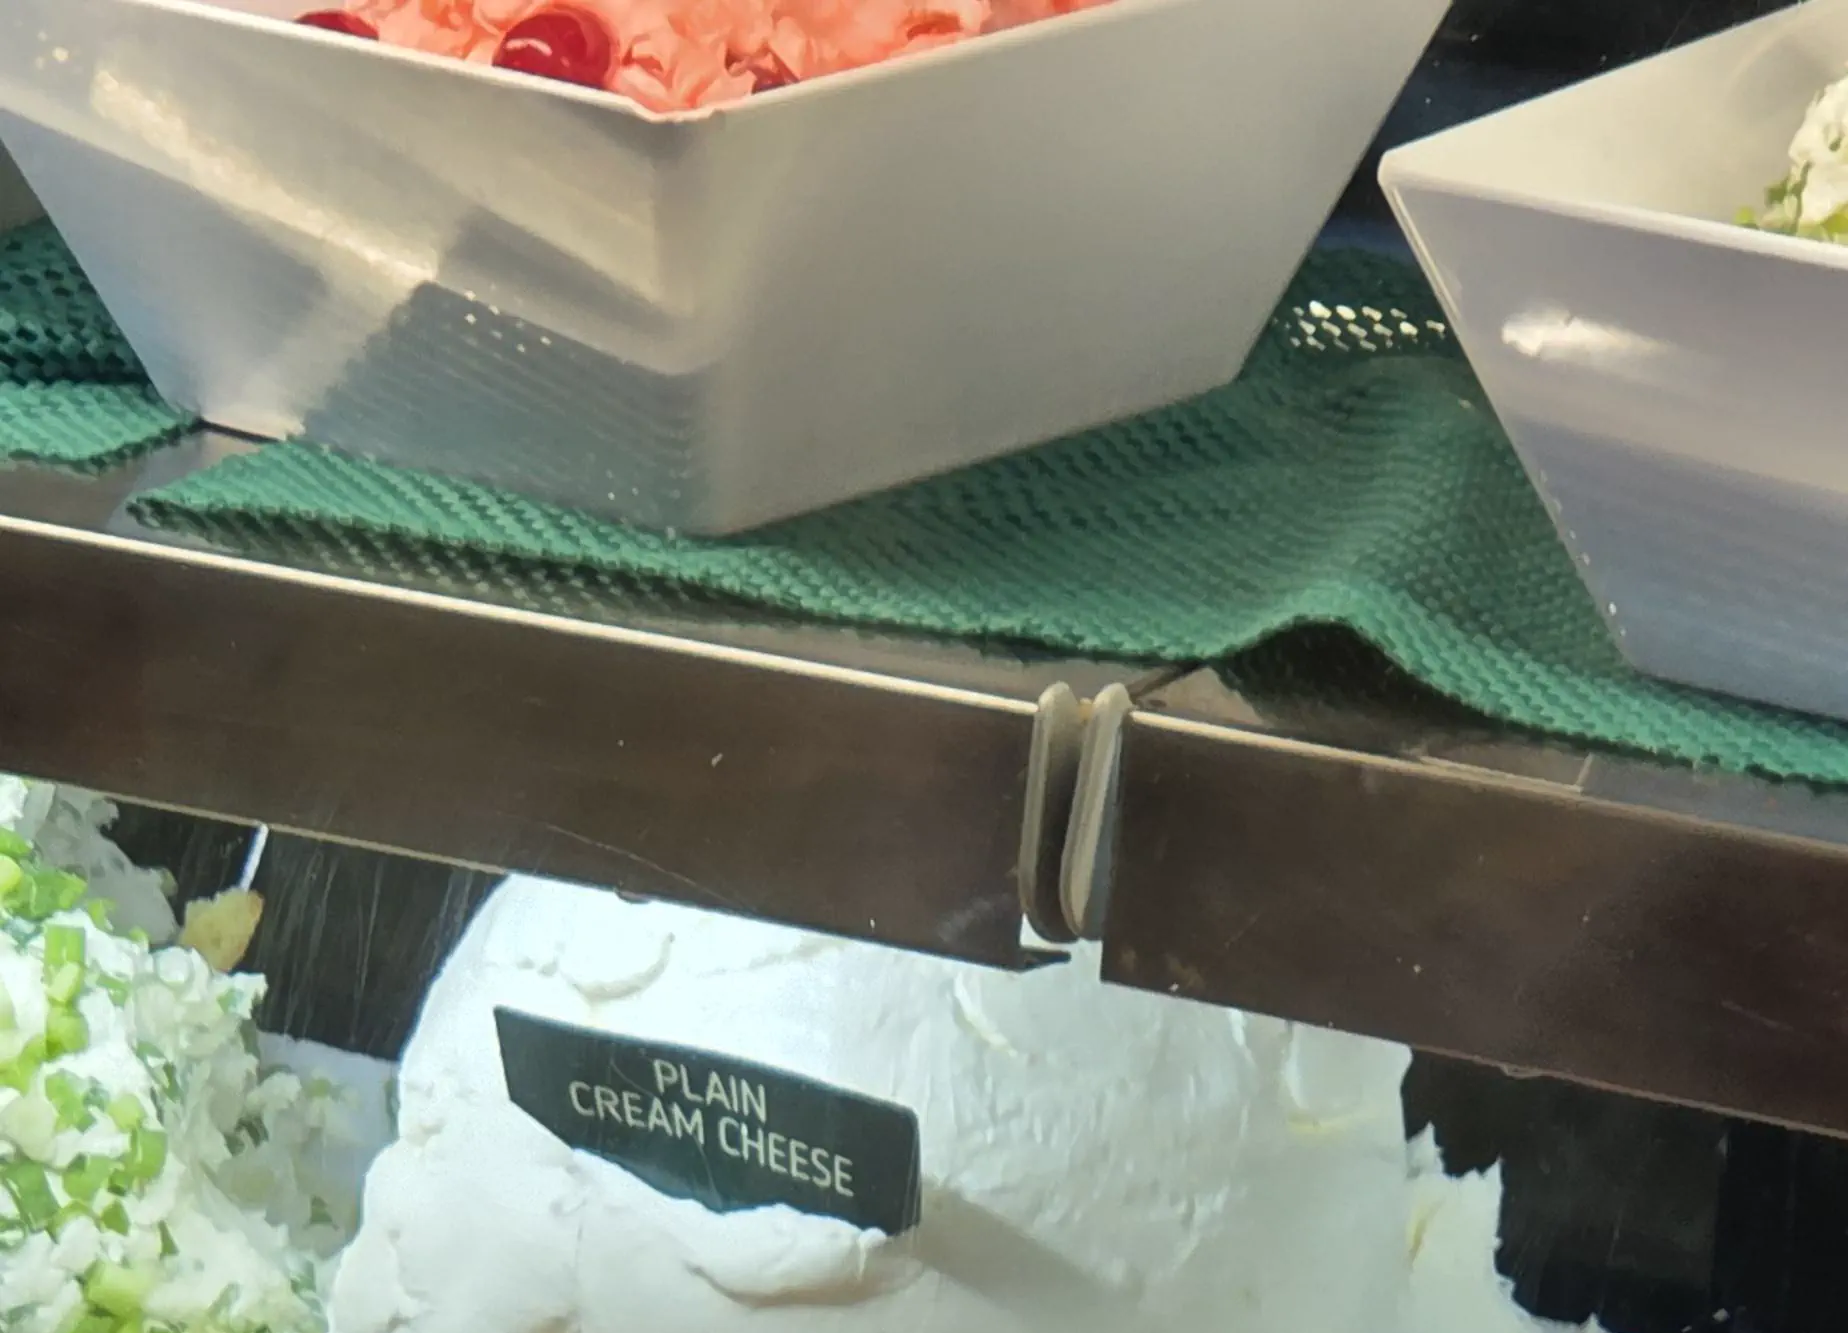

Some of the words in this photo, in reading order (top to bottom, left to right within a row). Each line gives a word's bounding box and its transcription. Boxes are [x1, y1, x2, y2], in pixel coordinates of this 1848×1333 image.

[653, 1058, 768, 1123] PLAIN
[568, 1080, 705, 1145] CREAM
[718, 1116, 855, 1197] CHEESE
